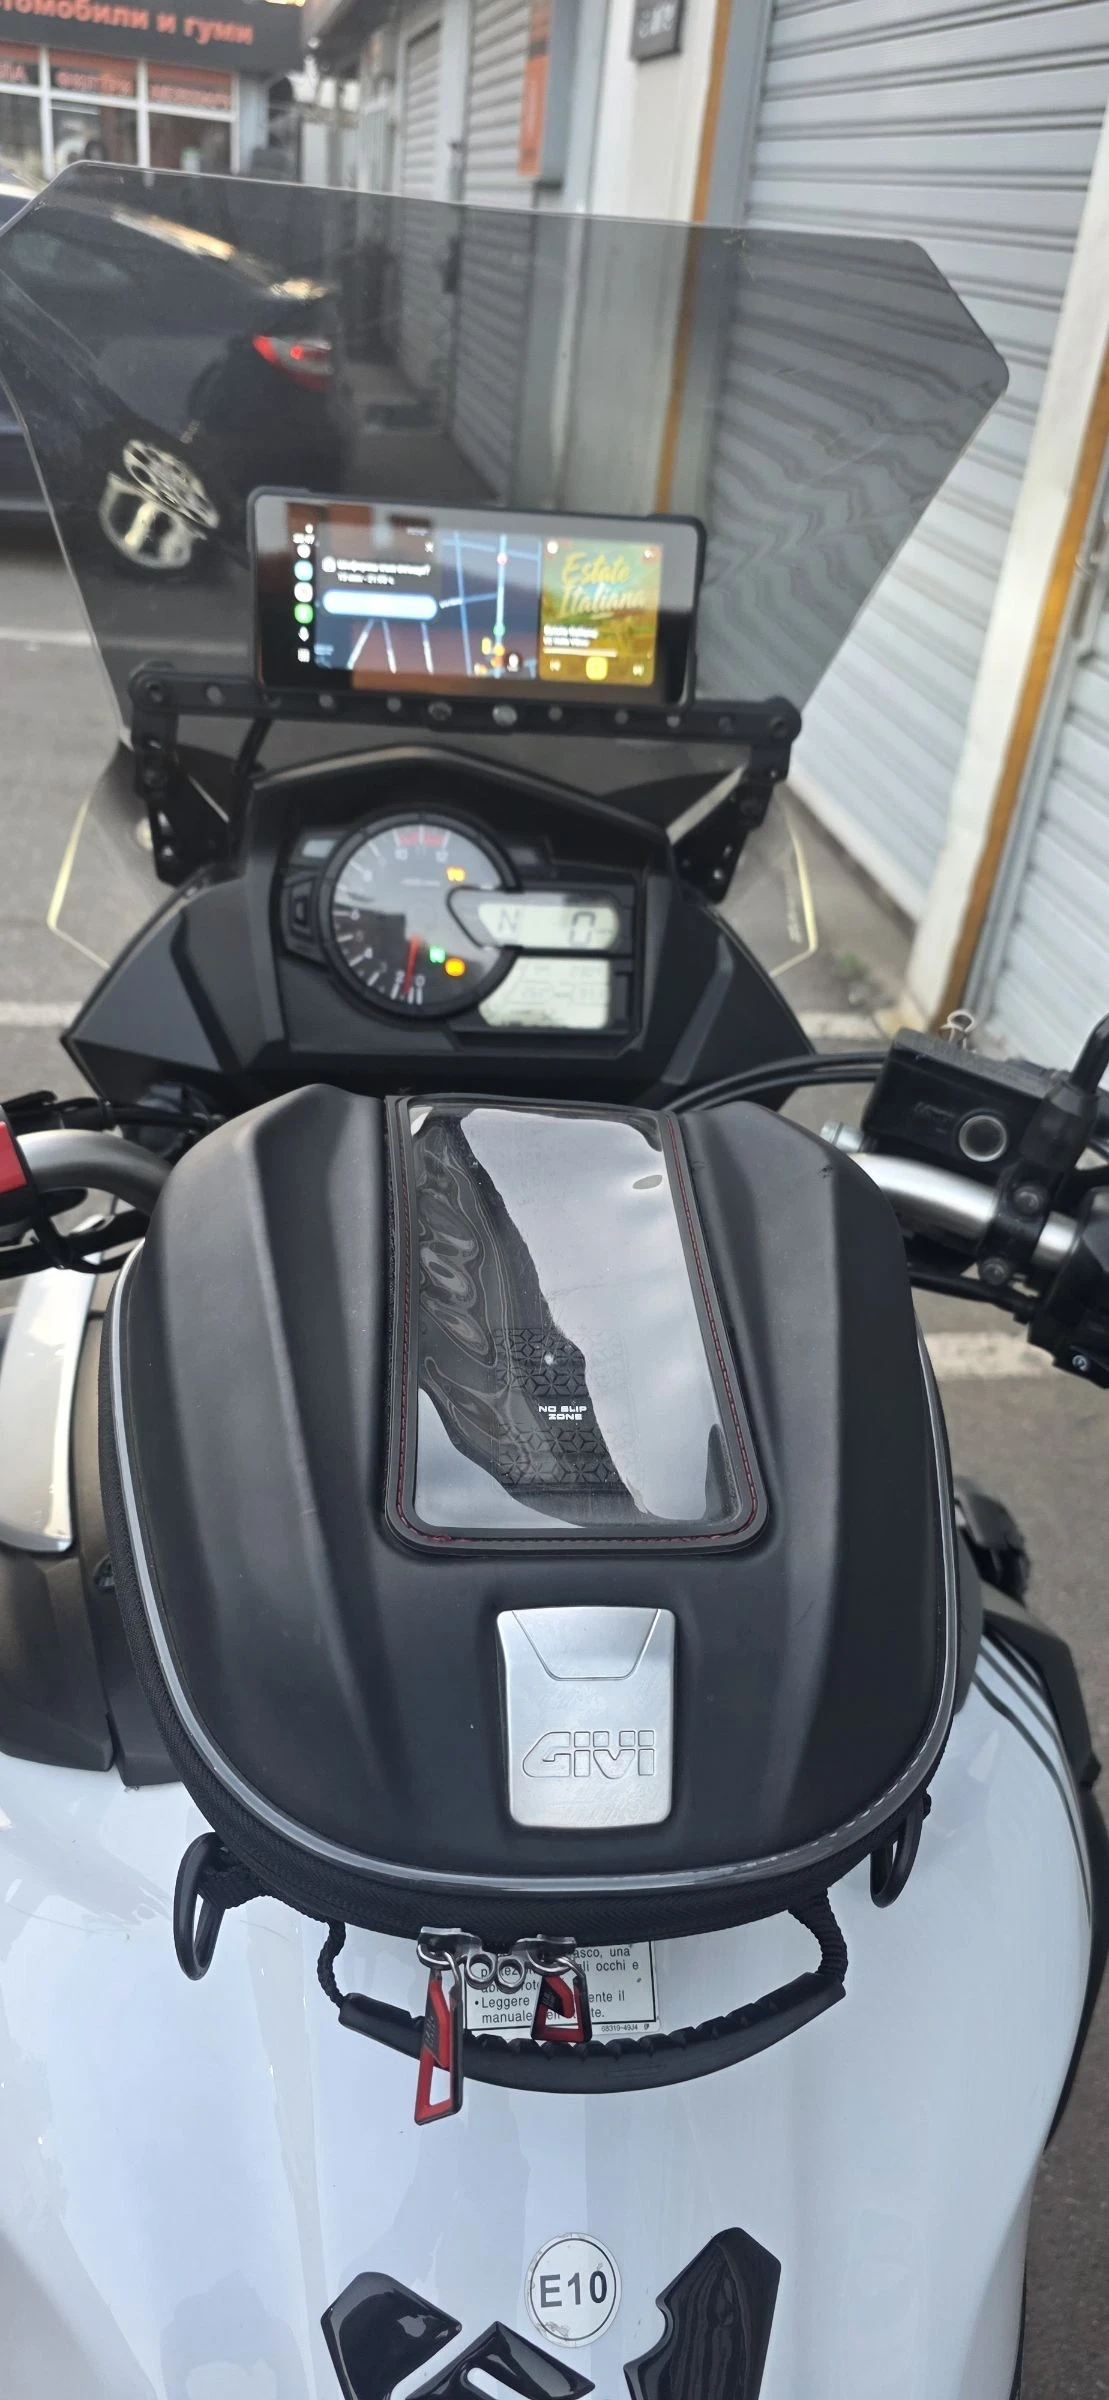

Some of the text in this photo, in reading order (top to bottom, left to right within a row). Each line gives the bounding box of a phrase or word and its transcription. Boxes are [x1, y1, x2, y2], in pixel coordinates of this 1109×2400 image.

[156, 12, 177, 34] и
[184, 17, 254, 45] гуми
[561, 552, 630, 586] Estate
[558, 582, 648, 619] Italiana
[499, 910, 596, 946] N 0
[522, 1730, 654, 1779] GIVI
[572, 1948, 631, 1959] asco, una
[596, 1960, 625, 1971] occhi
[632, 1961, 639, 1970] e
[481, 1997, 530, 2009] Leggere
[618, 1990, 625, 2001] il
[482, 2011, 533, 2024] manuale
[540, 2270, 608, 2308] E10
